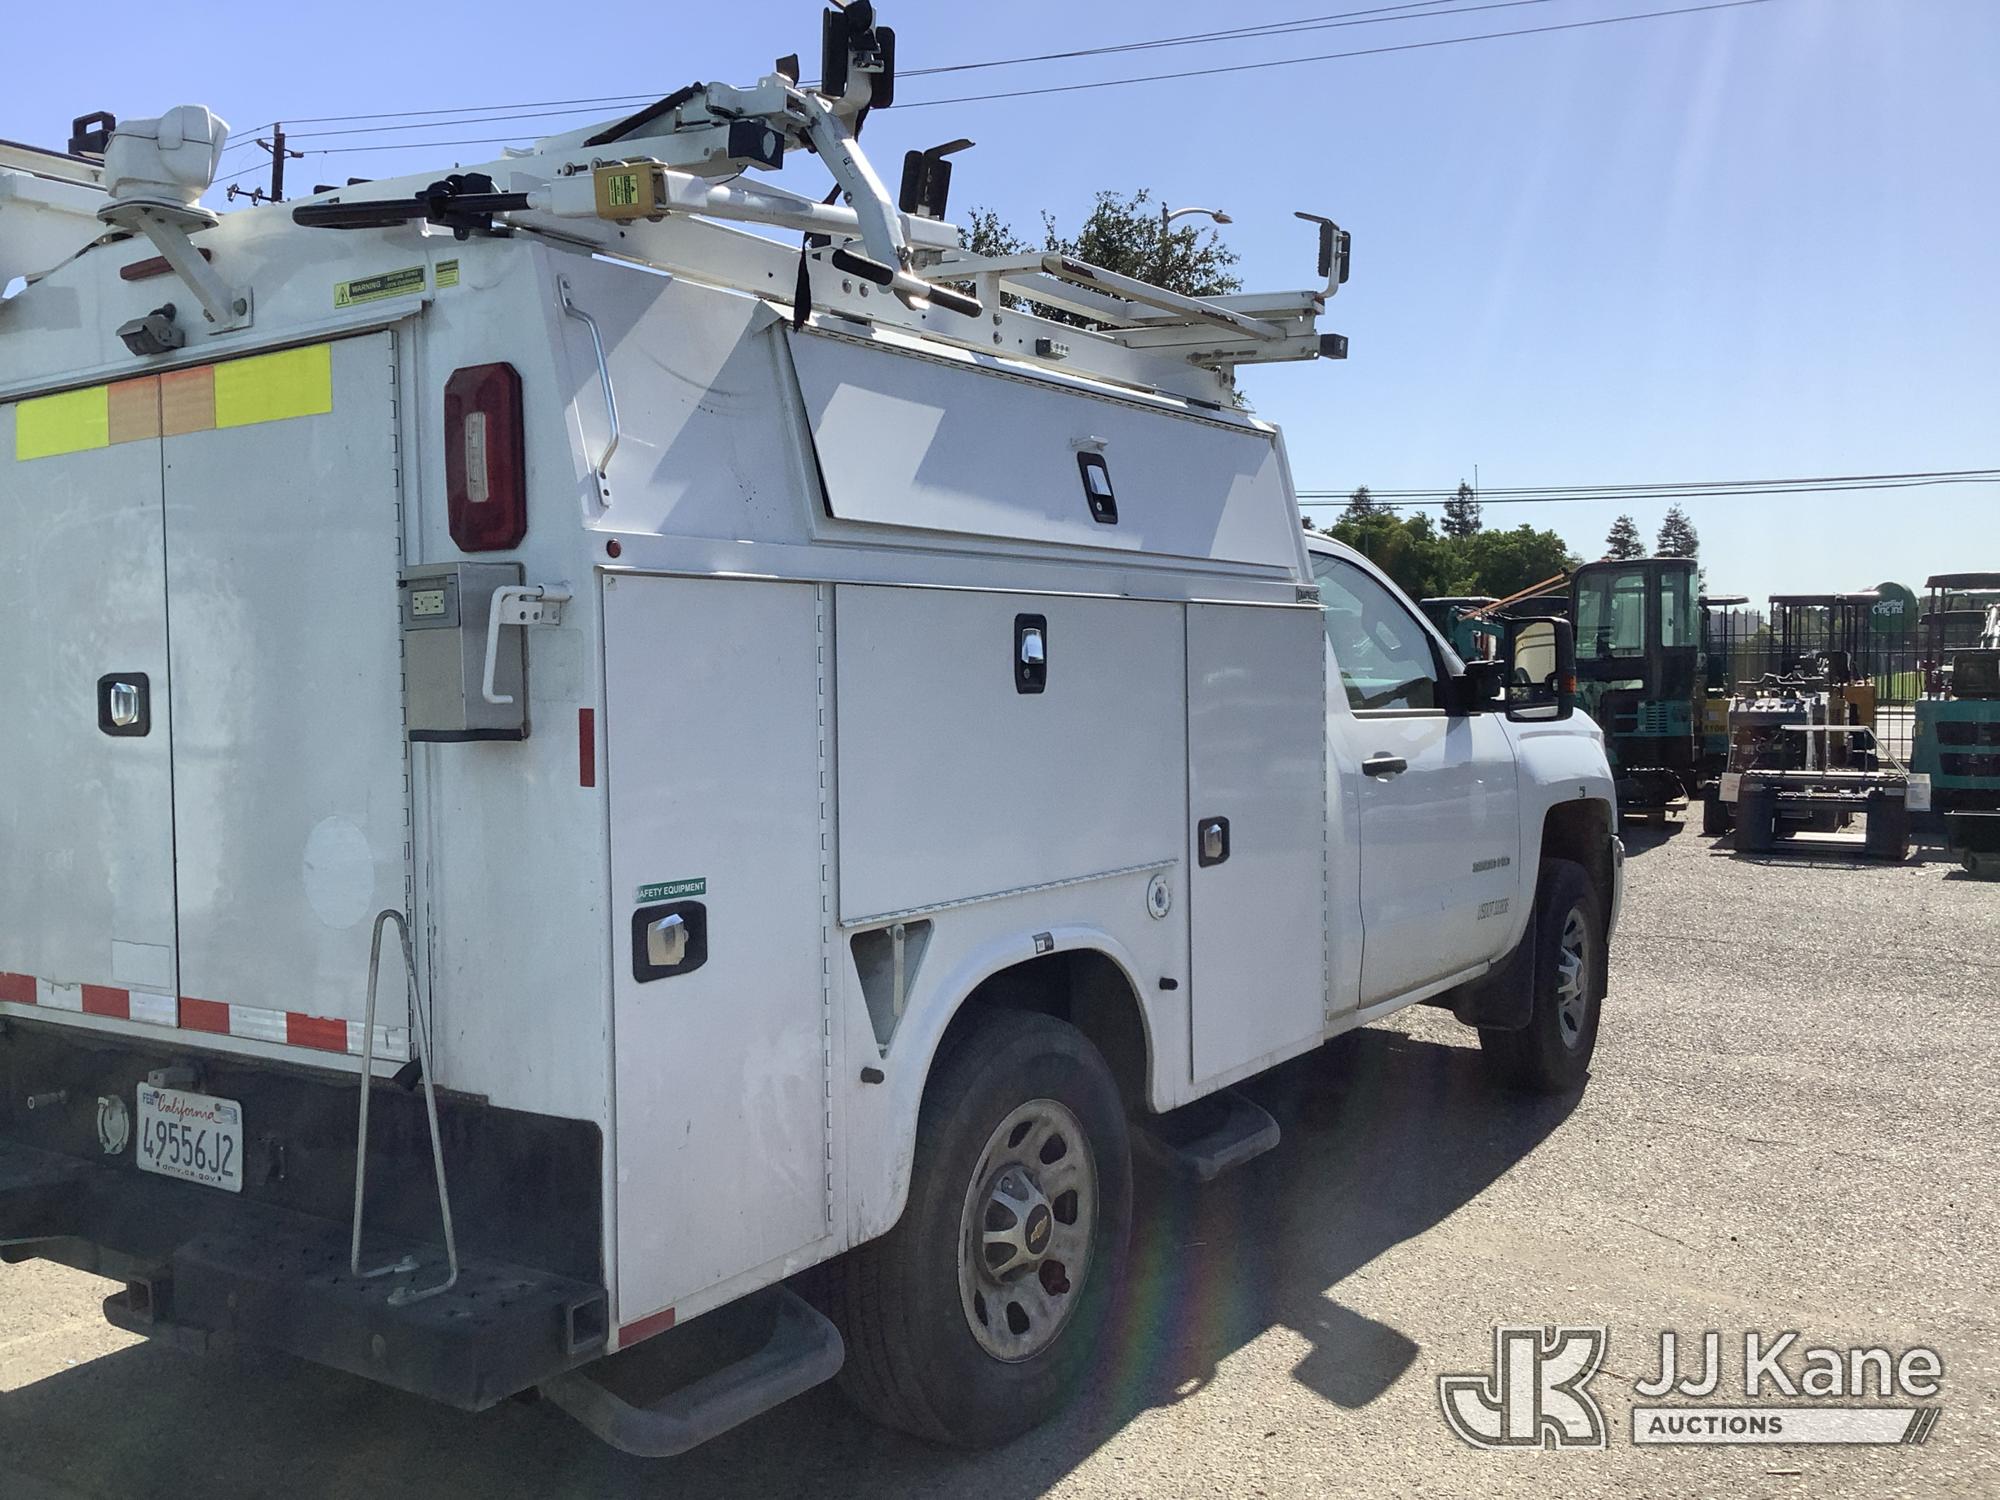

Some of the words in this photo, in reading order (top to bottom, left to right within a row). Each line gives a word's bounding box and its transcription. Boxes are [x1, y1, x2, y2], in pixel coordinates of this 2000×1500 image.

[351, 280, 381, 294] WARNING
[638, 887, 662, 898] AFETY
[663, 882, 705, 895] EQUIPMENT
[157, 1093, 223, 1124] California
[143, 1117, 234, 1177] 49556J2
[162, 1164, 216, 1182] dmv.ca.gov
